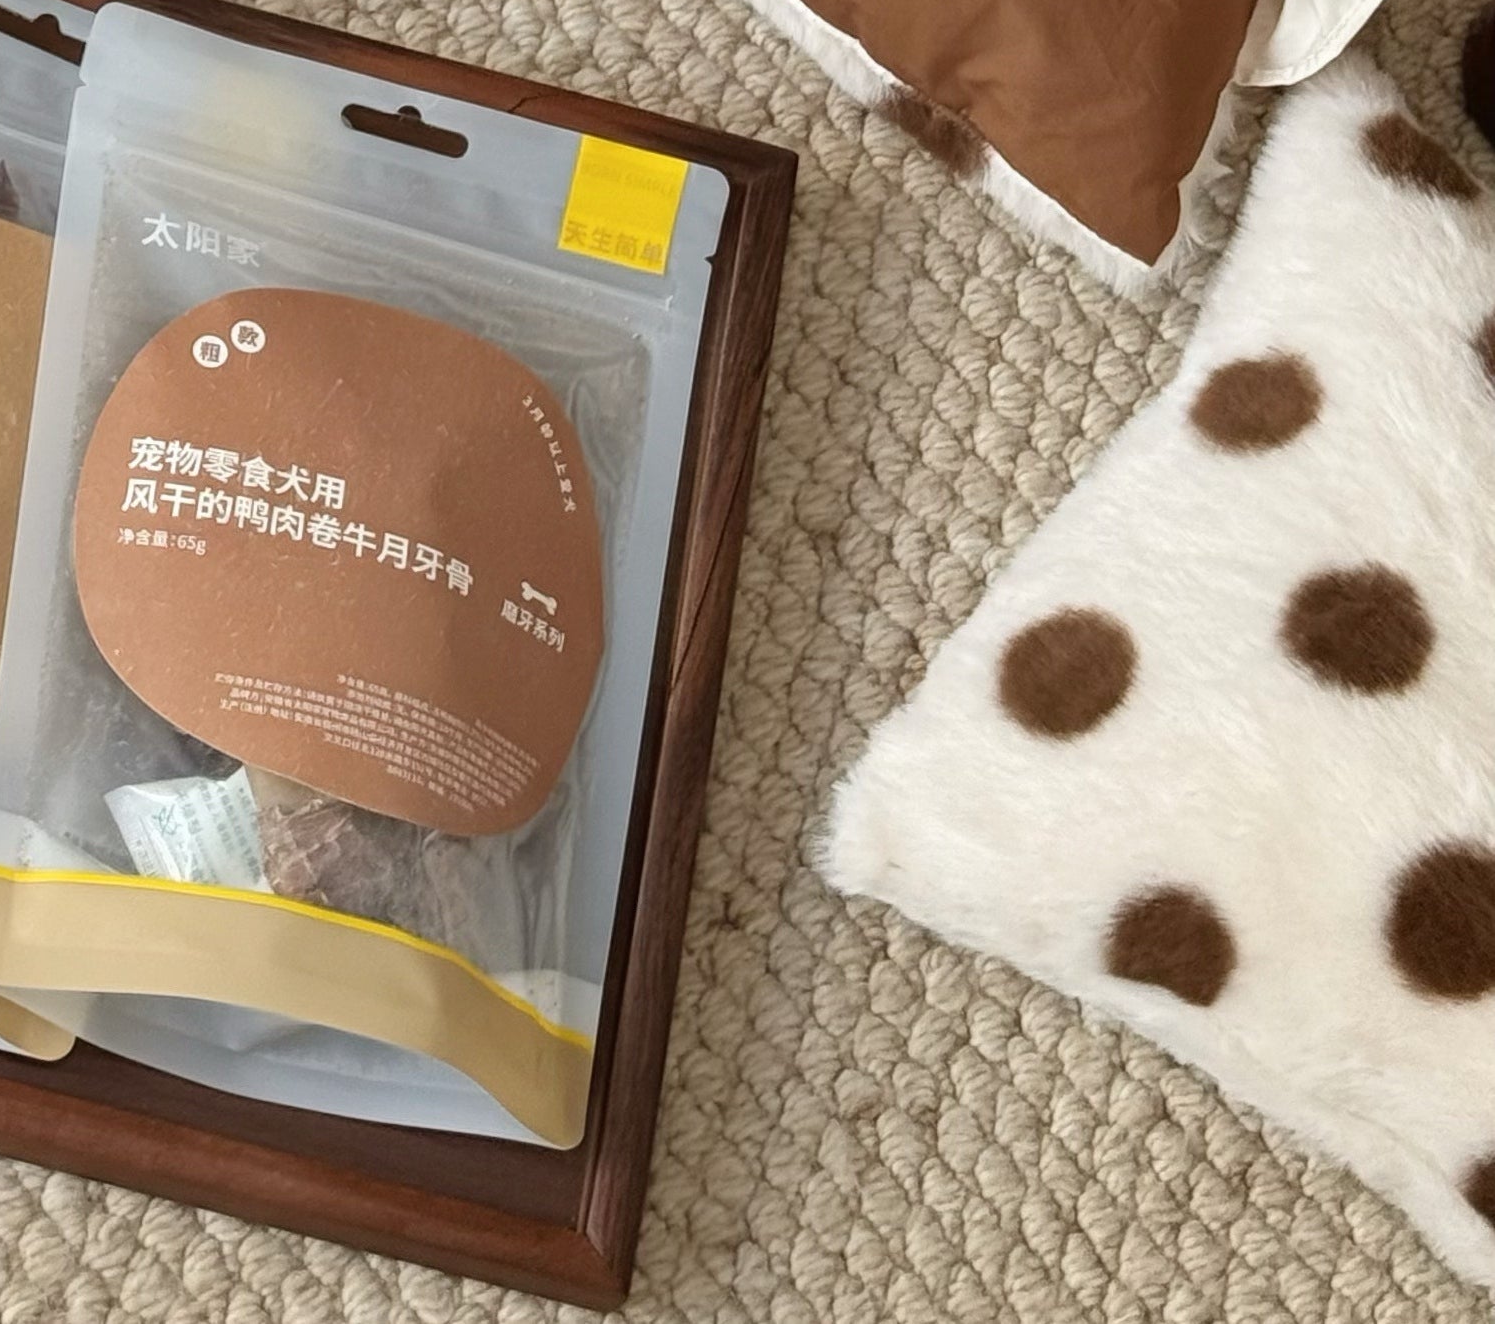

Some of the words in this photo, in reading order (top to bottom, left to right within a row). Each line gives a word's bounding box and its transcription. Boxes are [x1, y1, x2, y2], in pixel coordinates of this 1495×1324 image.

[141, 213, 262, 268] 太阳家
[563, 219, 667, 266] 天生简单
[127, 437, 345, 511] 宠物零食犬用
[121, 478, 474, 598] 风干的鸭肉卷牛月牙骨
[500, 601, 565, 653] 磨牙系列
